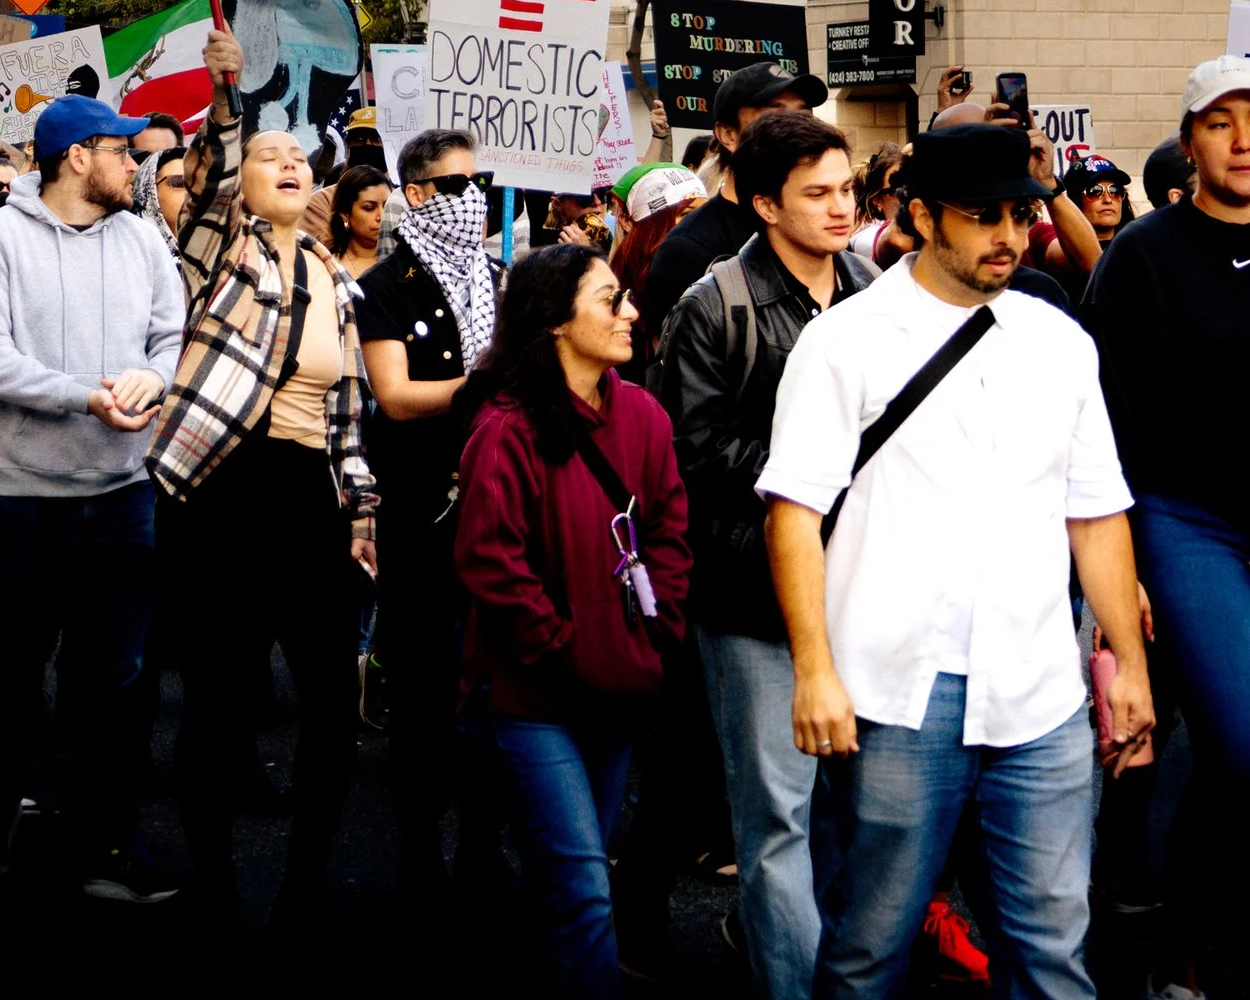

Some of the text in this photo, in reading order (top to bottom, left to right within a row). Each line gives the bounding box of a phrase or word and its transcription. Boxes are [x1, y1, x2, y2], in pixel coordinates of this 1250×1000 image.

[670, 13, 716, 30] STOP
[828, 26, 853, 38] TURNKEY
[689, 35, 784, 56] MURDERING
[832, 38, 869, 51] CREATIVE OFF
[0, 36, 90, 81] FUERA
[431, 30, 602, 98] DOMESTIC
[778, 59, 799, 73] US
[29, 67, 69, 94] ICE
[664, 65, 702, 79] STOP
[676, 96, 708, 112] OUR
[384, 107, 418, 133] LA
[429, 88, 597, 156] TERRORISTS
[547, 157, 584, 172] THUGS
